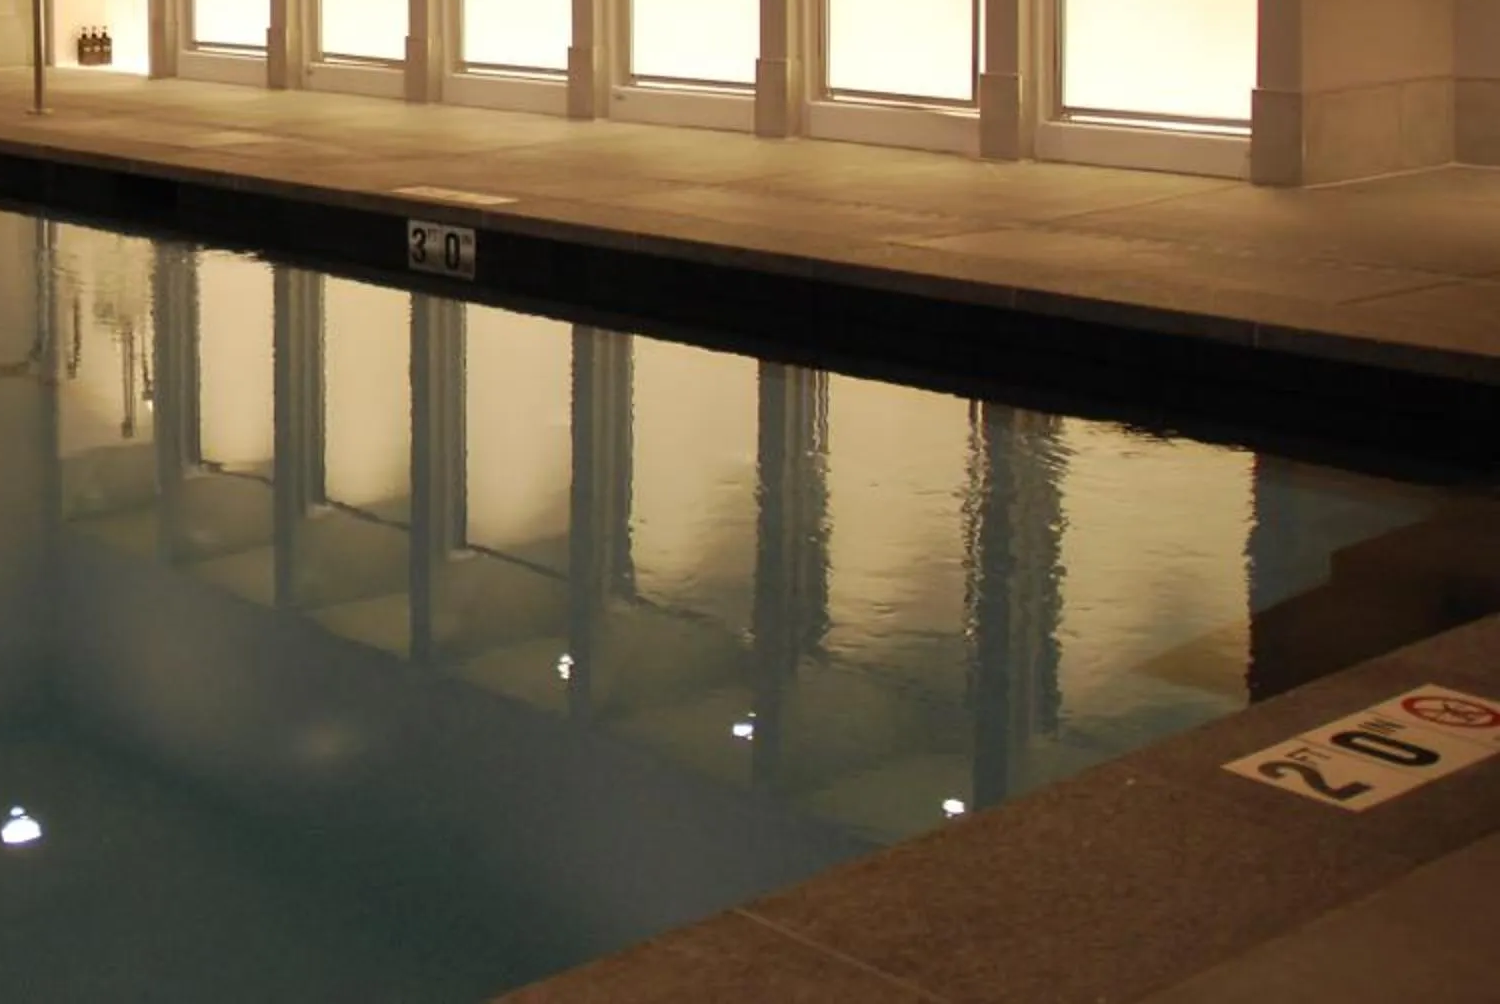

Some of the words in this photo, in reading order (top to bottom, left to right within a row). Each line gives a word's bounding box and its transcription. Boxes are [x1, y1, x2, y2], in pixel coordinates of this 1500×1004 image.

[411, 227, 427, 263] 3
[445, 231, 461, 270] 0
[1257, 759, 1373, 801] 2
[1329, 731, 1442, 767] 0
